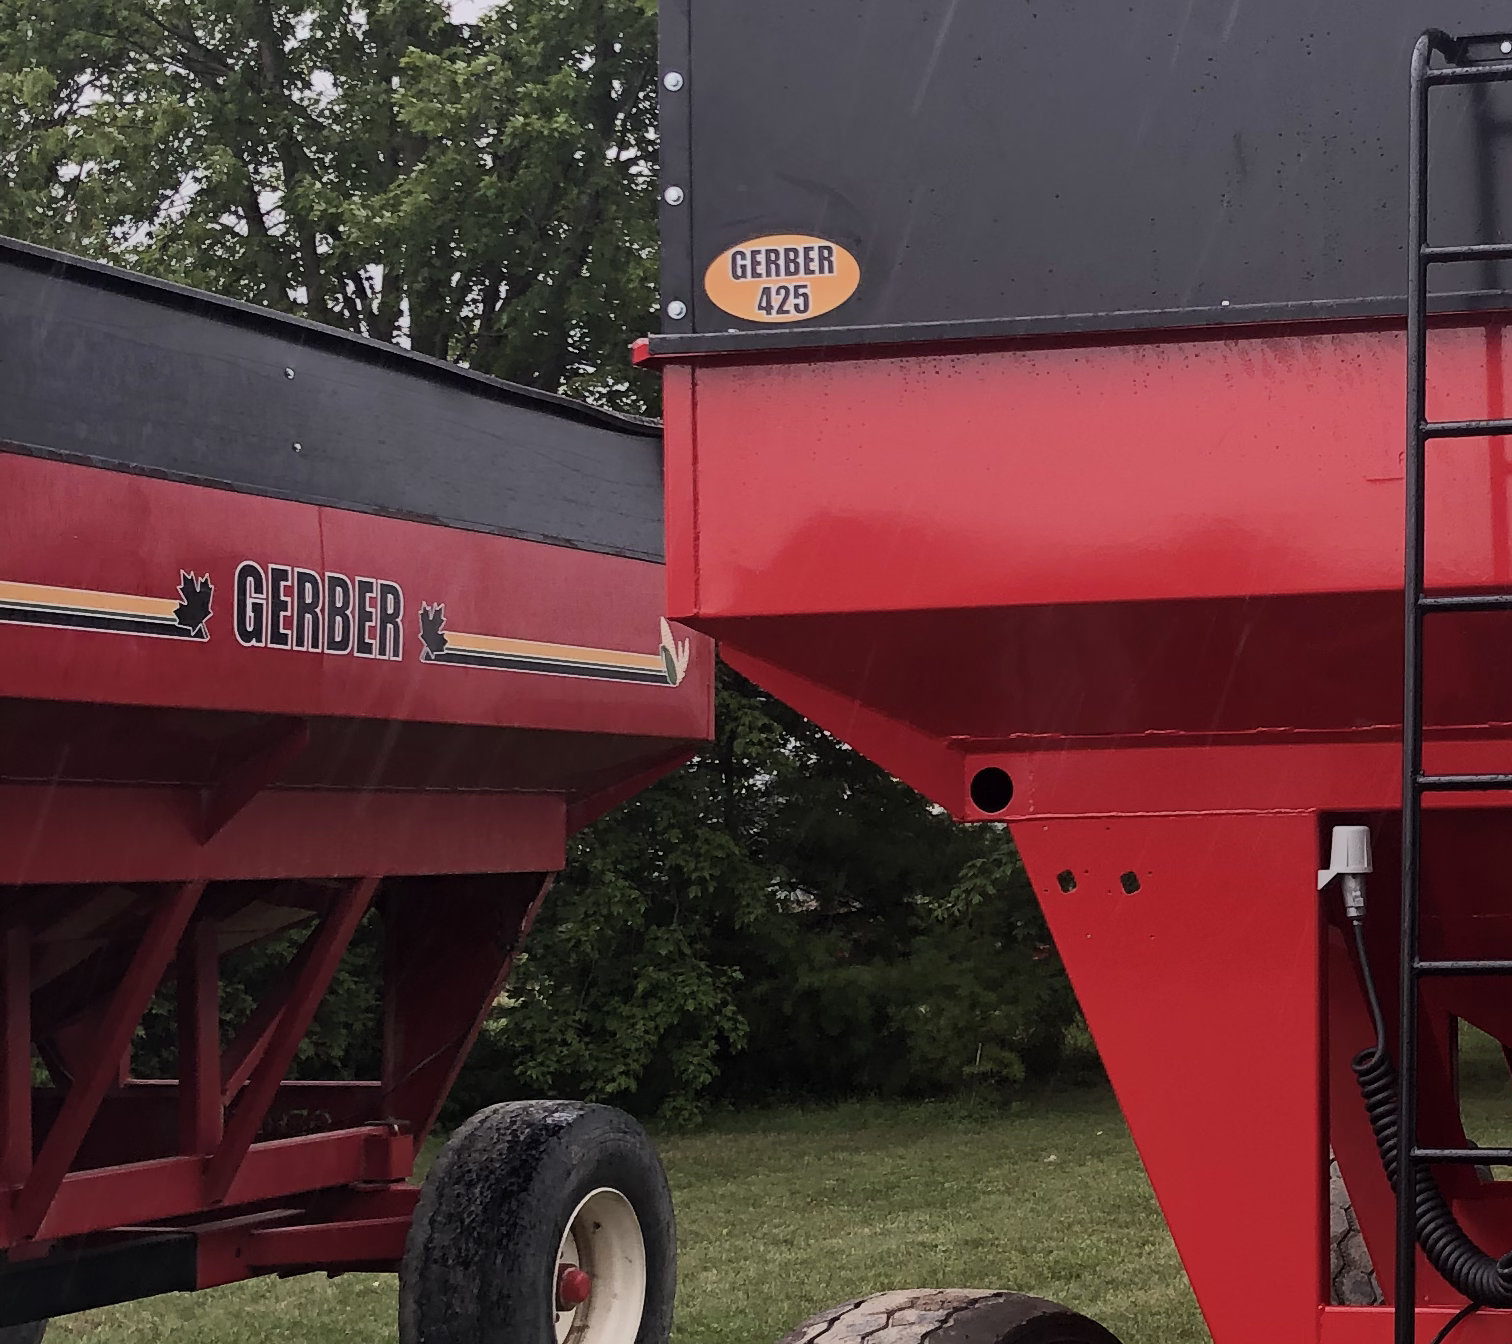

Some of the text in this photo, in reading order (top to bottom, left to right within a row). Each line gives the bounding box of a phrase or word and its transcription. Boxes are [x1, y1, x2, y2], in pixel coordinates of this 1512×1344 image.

[730, 245, 834, 281] GERBER
[757, 284, 810, 316] 425
[235, 561, 404, 661] GERBER
